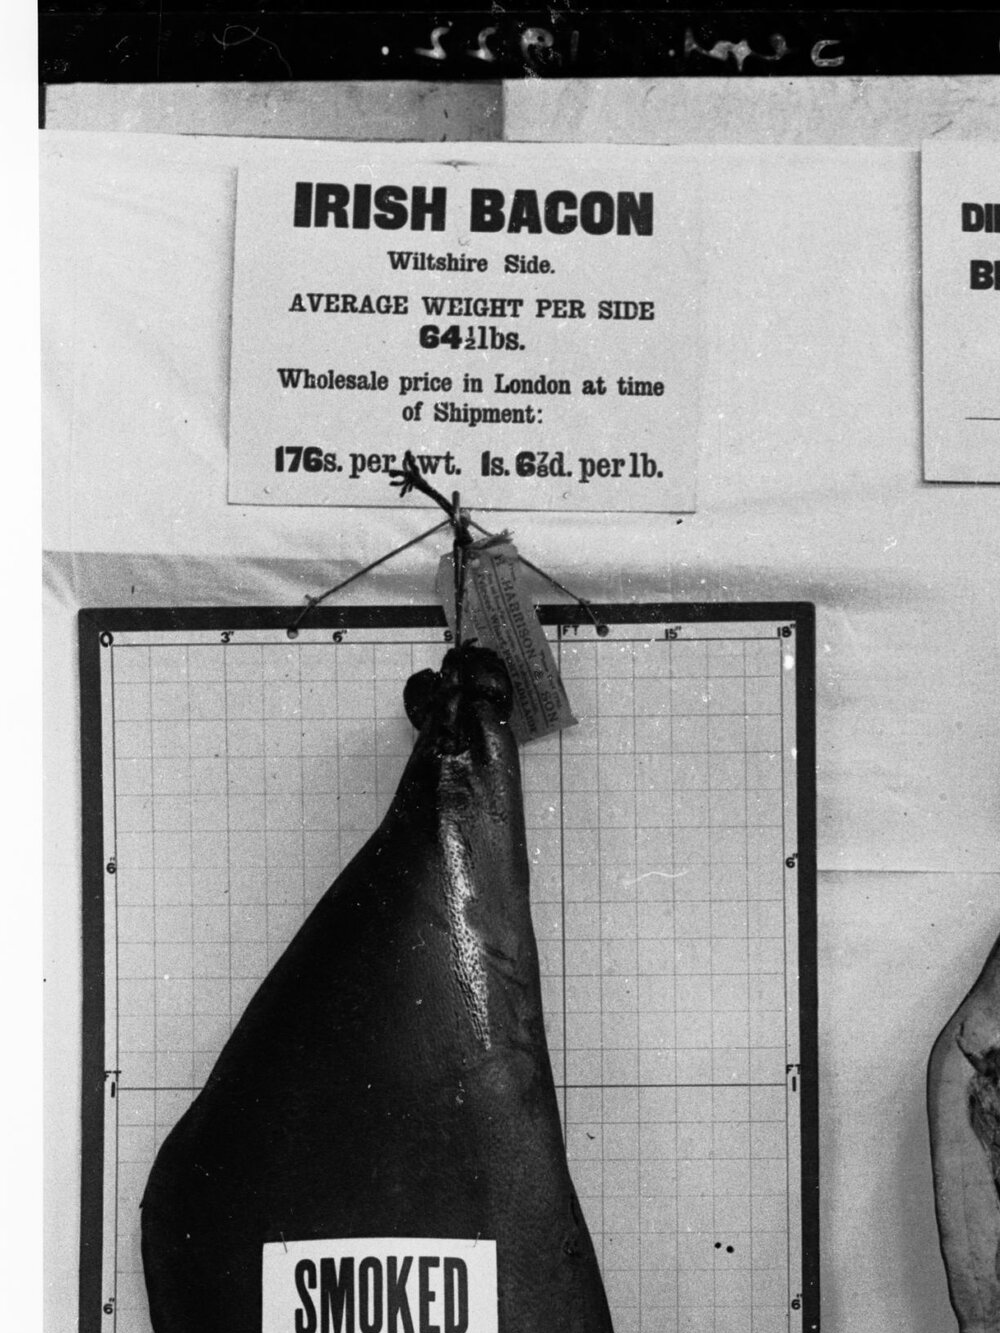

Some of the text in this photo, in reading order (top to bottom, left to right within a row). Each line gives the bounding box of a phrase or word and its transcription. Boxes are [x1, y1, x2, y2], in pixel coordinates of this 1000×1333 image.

[293, 181, 654, 237] IRISH BACON
[387, 250, 555, 274] Wiltshire Side.
[288, 293, 655, 321] AVERAGE WEIGHT PER SIDE
[276, 368, 665, 397] Wholesale price in London at time
[402, 400, 543, 428] of Shipment:
[275, 445, 343, 473] 176s.
[348, 452, 397, 479] per
[578, 457, 626, 484] per
[629, 452, 664, 478] lb.
[501, 577, 538, 660] HARRISON
